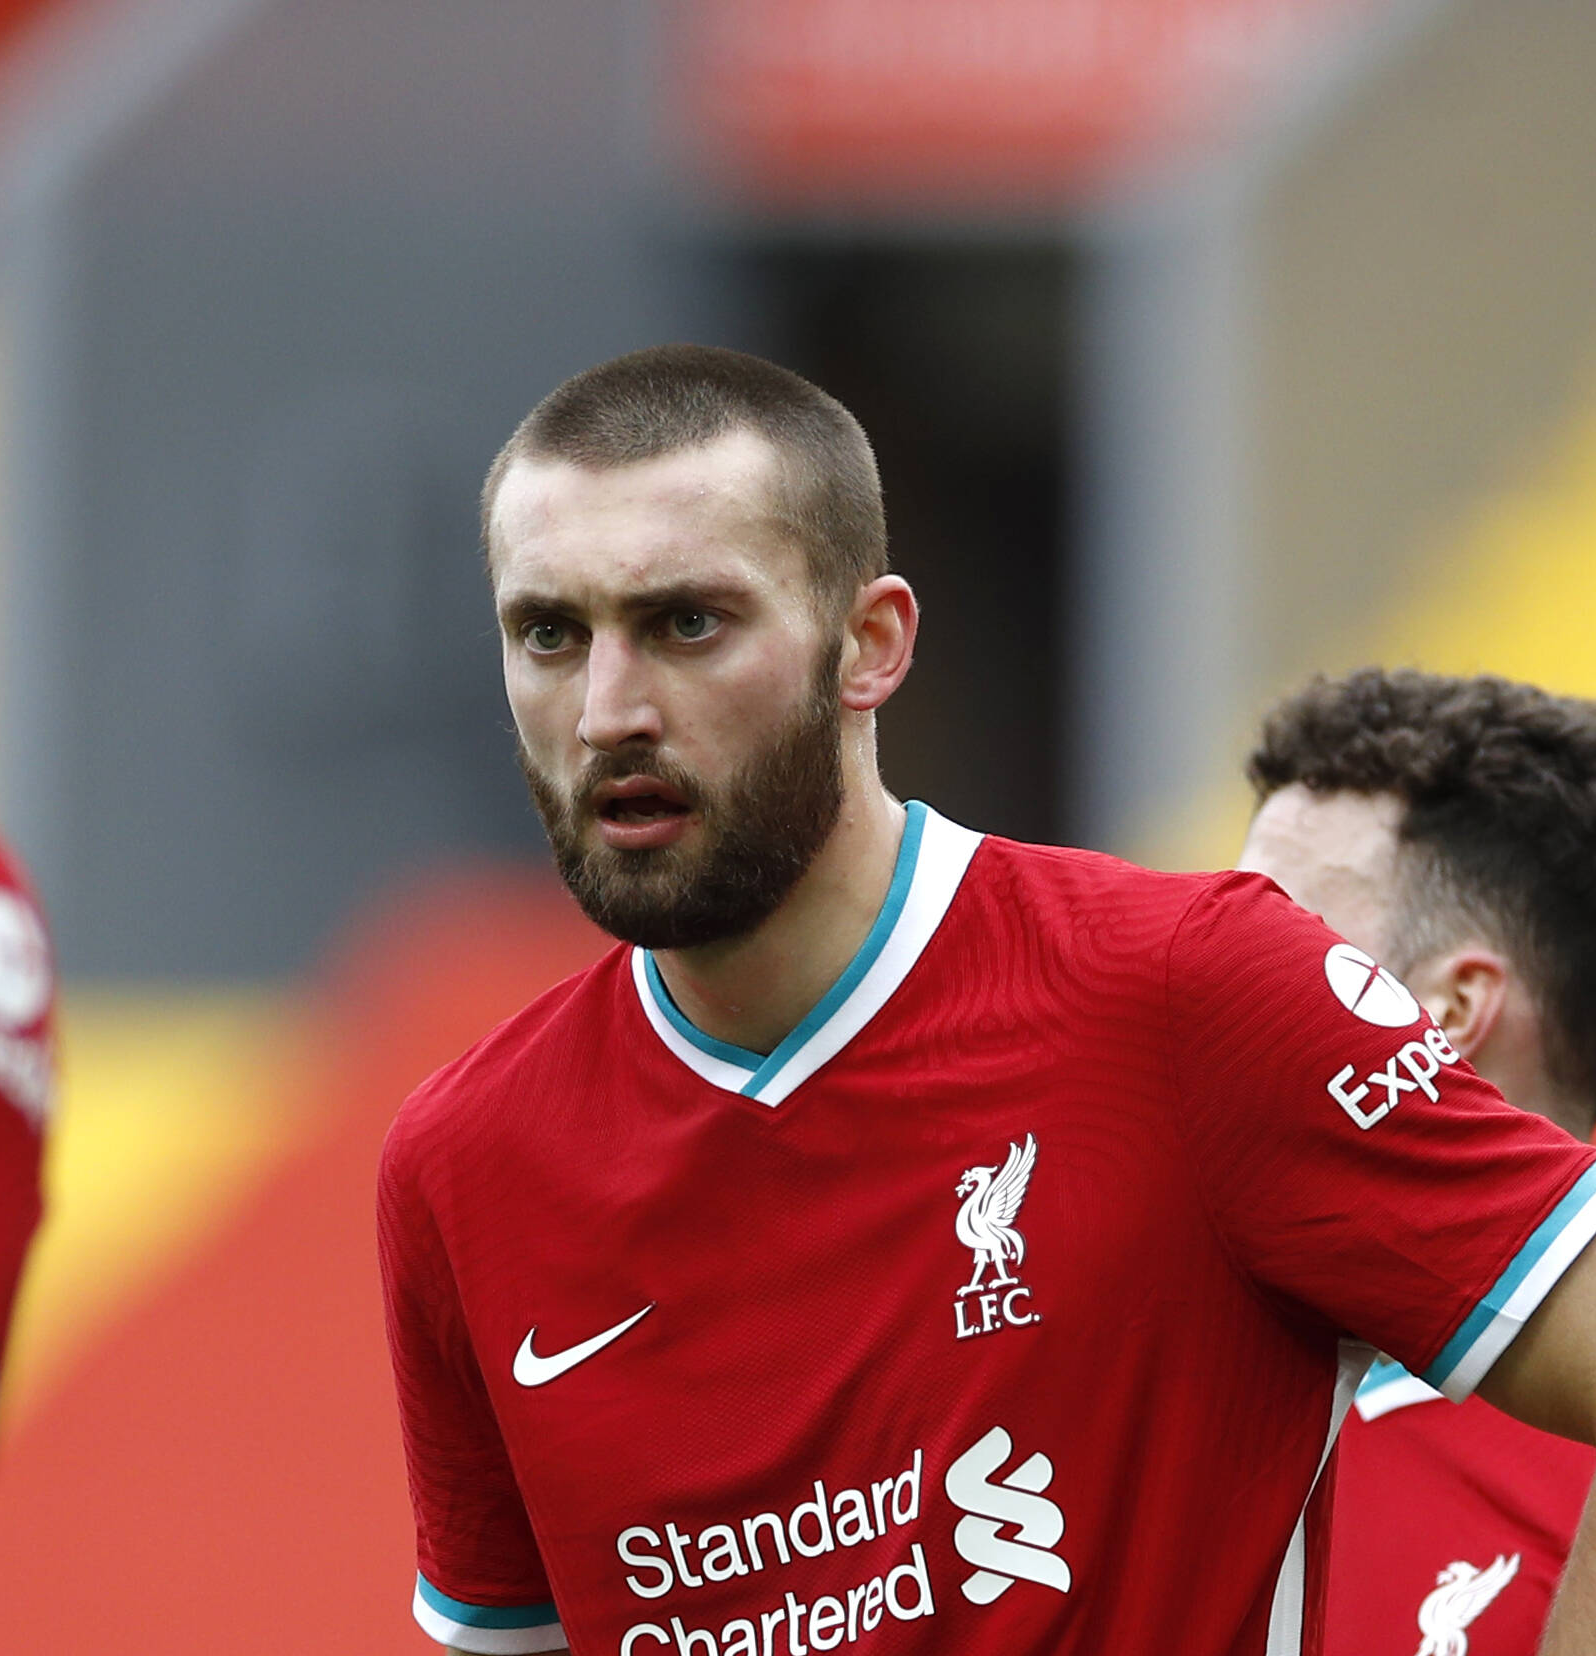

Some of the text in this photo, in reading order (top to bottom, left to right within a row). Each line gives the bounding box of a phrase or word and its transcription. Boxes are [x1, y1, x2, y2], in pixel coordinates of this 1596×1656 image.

[1327, 1011, 1461, 1131] Expe
[954, 1288, 1042, 1340] L.F.C.
[617, 1448, 923, 1599] Standard
